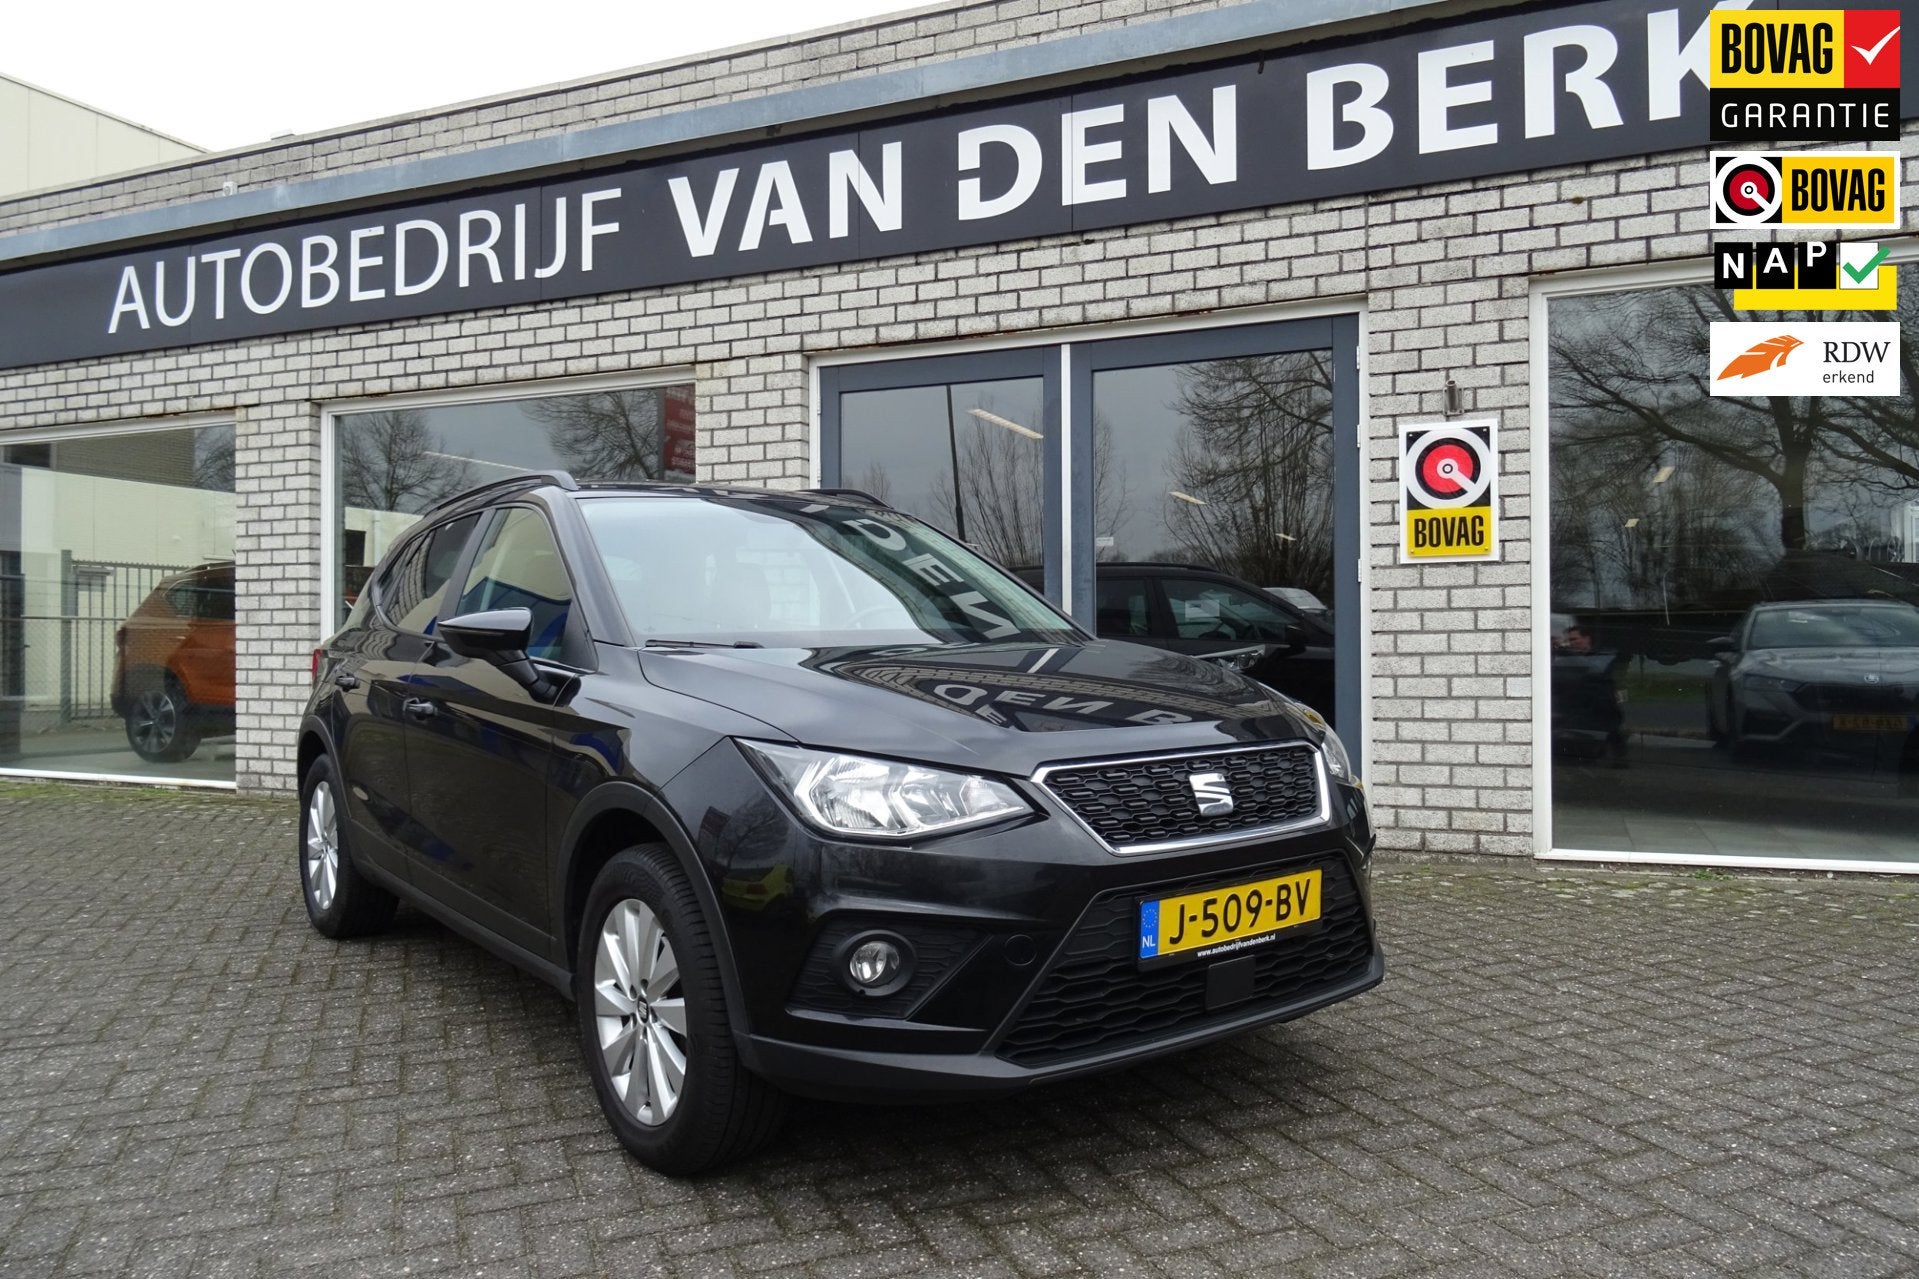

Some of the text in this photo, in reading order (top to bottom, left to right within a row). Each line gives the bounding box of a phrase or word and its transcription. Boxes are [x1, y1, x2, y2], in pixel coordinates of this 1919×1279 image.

[107, 187, 622, 334] AUTOBEDRIJF
[667, 140, 903, 258] VAN
[957, 84, 1237, 221] DEN
[1413, 514, 1485, 549] BOVAG
[1141, 877, 1311, 949] NL J-509-BV
[1196, 933, 1277, 958] www.autobedrijfvandenberk.nl
